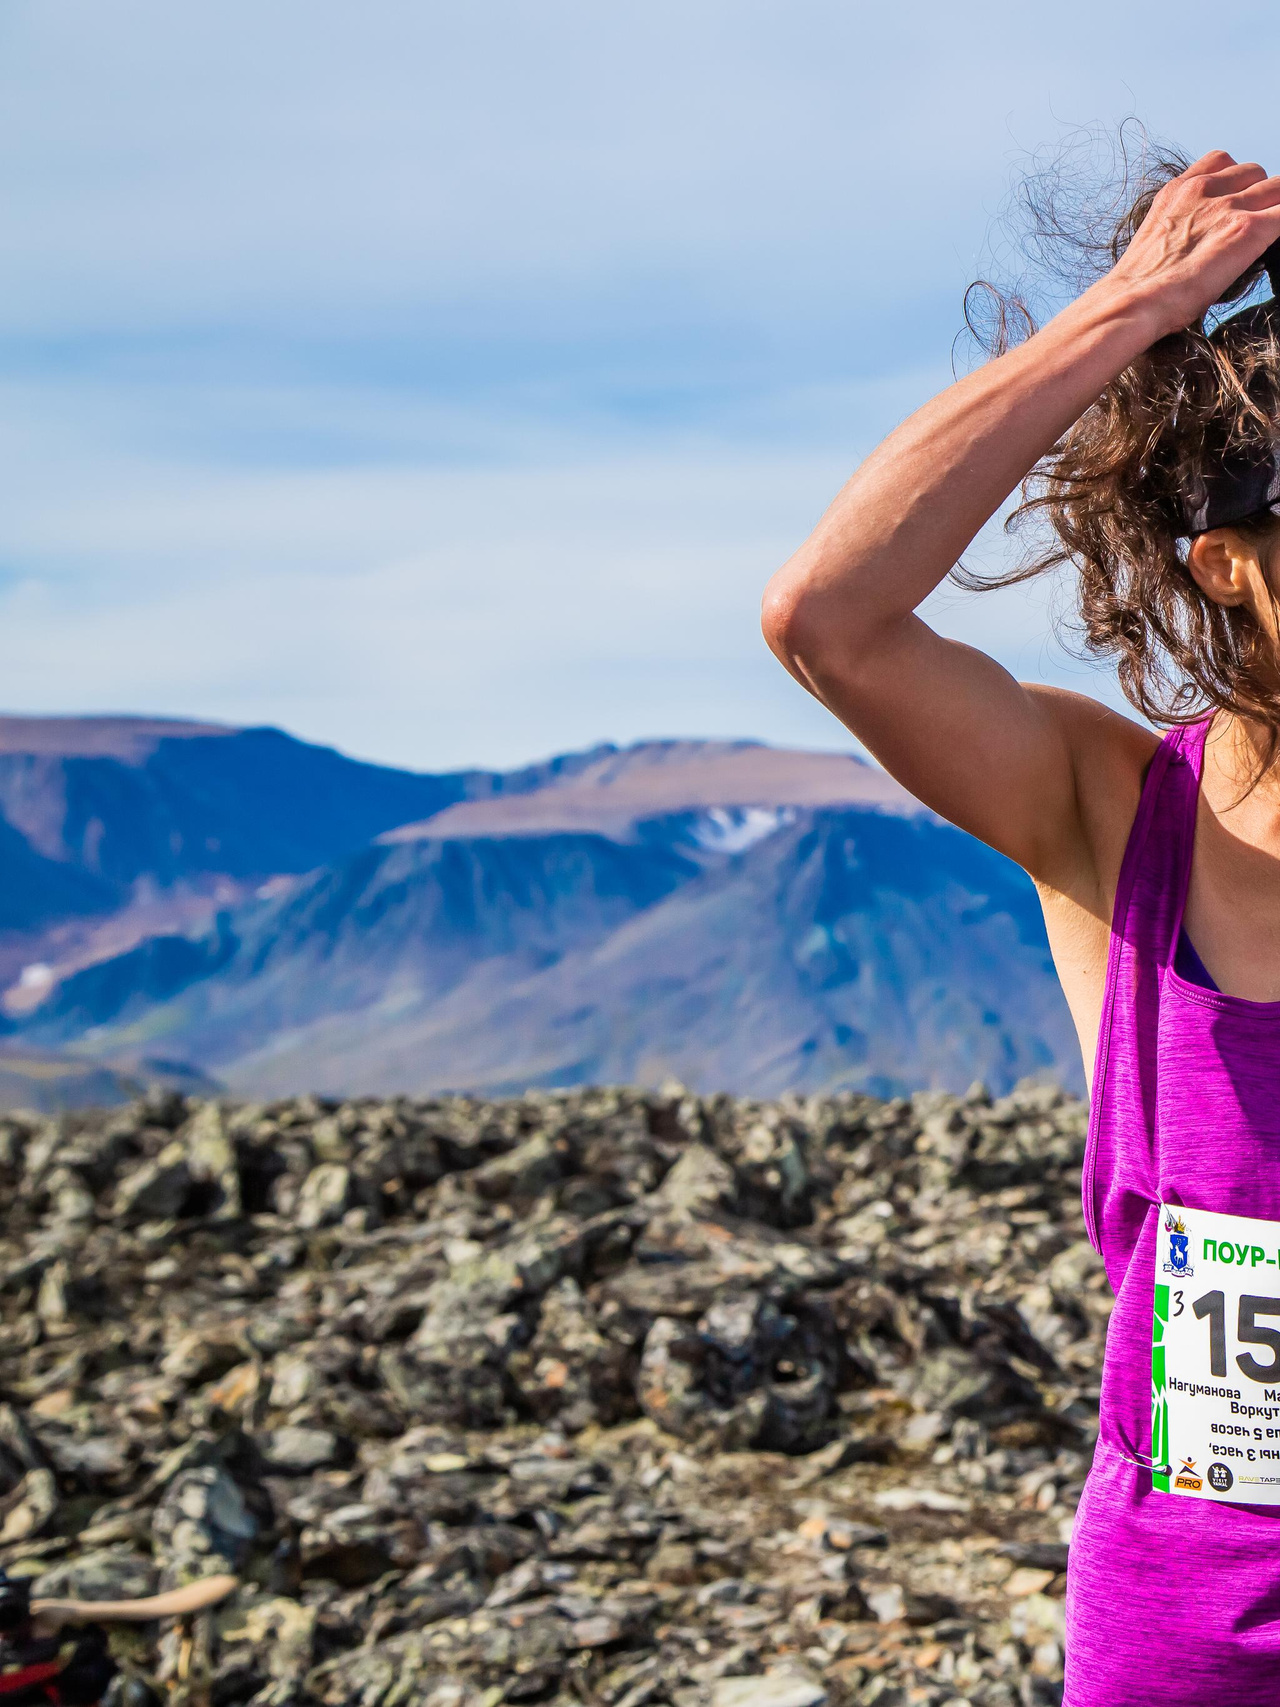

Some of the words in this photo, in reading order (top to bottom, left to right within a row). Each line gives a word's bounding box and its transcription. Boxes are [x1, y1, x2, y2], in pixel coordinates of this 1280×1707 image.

[1169, 1376, 1241, 1399] Нагуманова
[1210, 1423, 1250, 1437] часов
[1253, 1427, 1263, 1440] 5
[1208, 1443, 1244, 1458] часа,
[1246, 1448, 1257, 1461] 3
[1176, 1478, 1202, 1489] PRO
